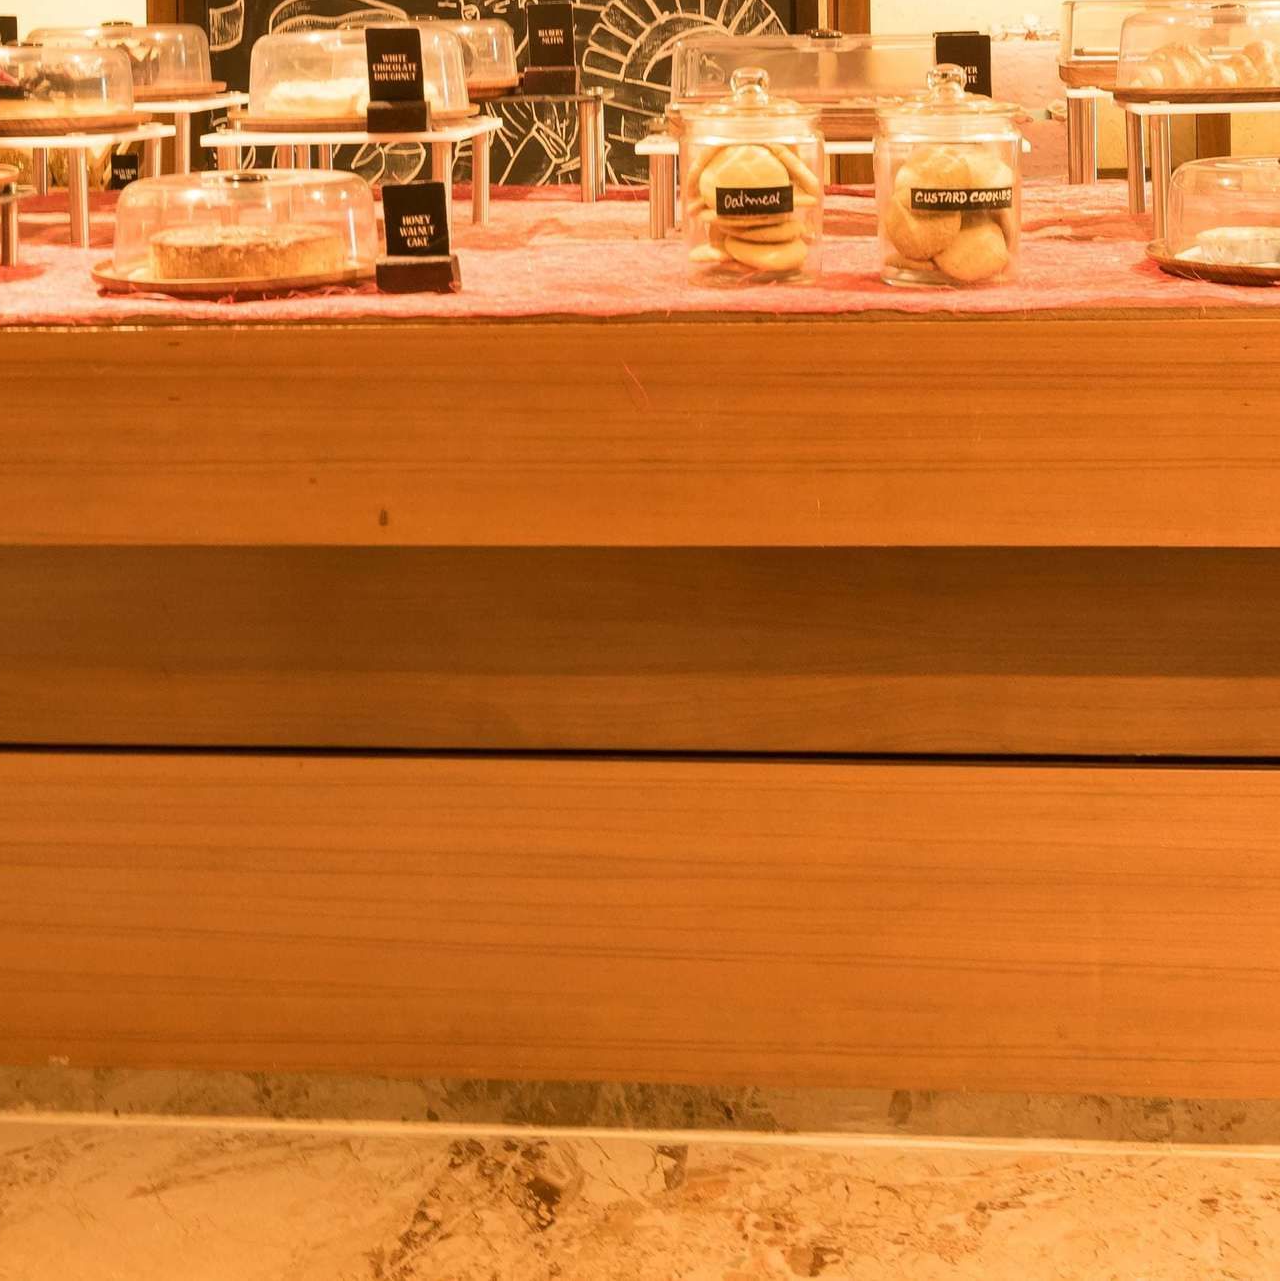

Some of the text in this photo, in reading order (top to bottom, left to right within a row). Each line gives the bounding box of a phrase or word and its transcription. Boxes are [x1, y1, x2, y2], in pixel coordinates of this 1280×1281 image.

[382, 54, 407, 63] WHITE
[372, 62, 417, 72] CHOCOLATE
[374, 72, 417, 82] DOUGHNUT
[915, 191, 967, 204] CUSTARD
[402, 214, 431, 226] HONEY
[400, 225, 435, 237] WALNUT
[406, 237, 430, 248] CAKE
